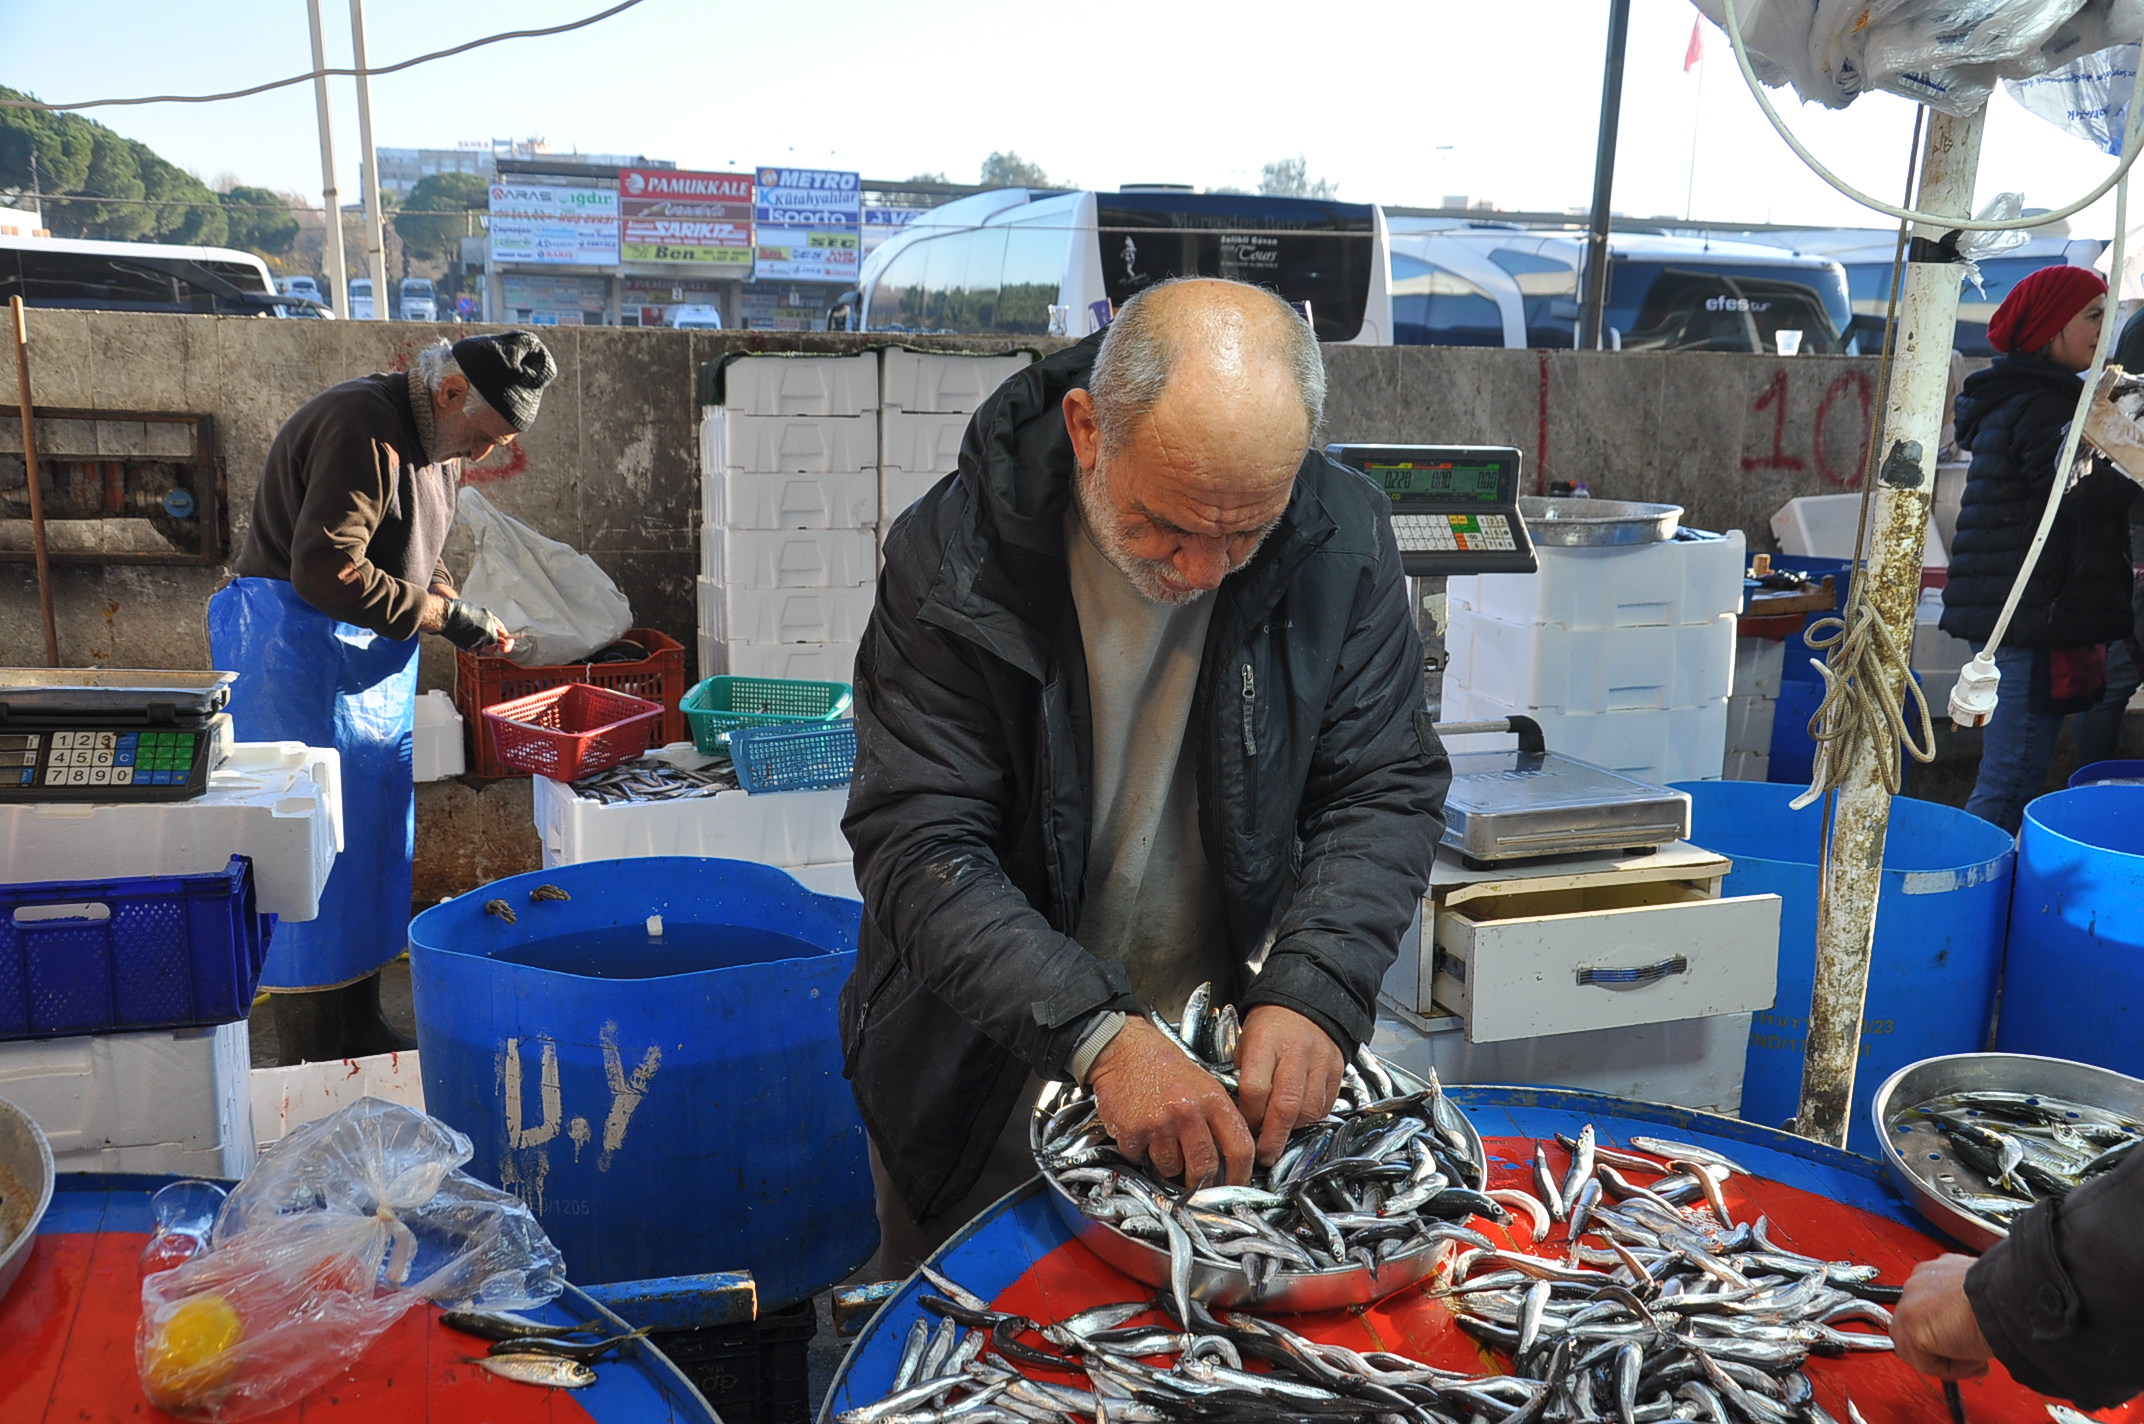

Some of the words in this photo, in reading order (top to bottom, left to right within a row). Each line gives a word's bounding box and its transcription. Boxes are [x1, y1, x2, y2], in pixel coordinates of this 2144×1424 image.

[647, 177, 749, 197] PAMUKKALE
[779, 171, 855, 190] METRO
[504, 190, 552, 201] ARAS
[655, 246, 695, 260] Ben
[1706, 295, 1749, 312] efes
[1740, 368, 1874, 488] 10
[59, 735, 67, 746] 1
[80, 735, 91, 746] 2
[100, 735, 111, 746] 3
[54, 752, 65, 763] 4
[76, 752, 87, 763] 5
[97, 752, 109, 764] 6
[119, 753, 130, 763] C
[52, 770, 63, 781] 7
[73, 770, 84, 781] 8
[95, 770, 106, 781] 9
[117, 770, 127, 781] 0
